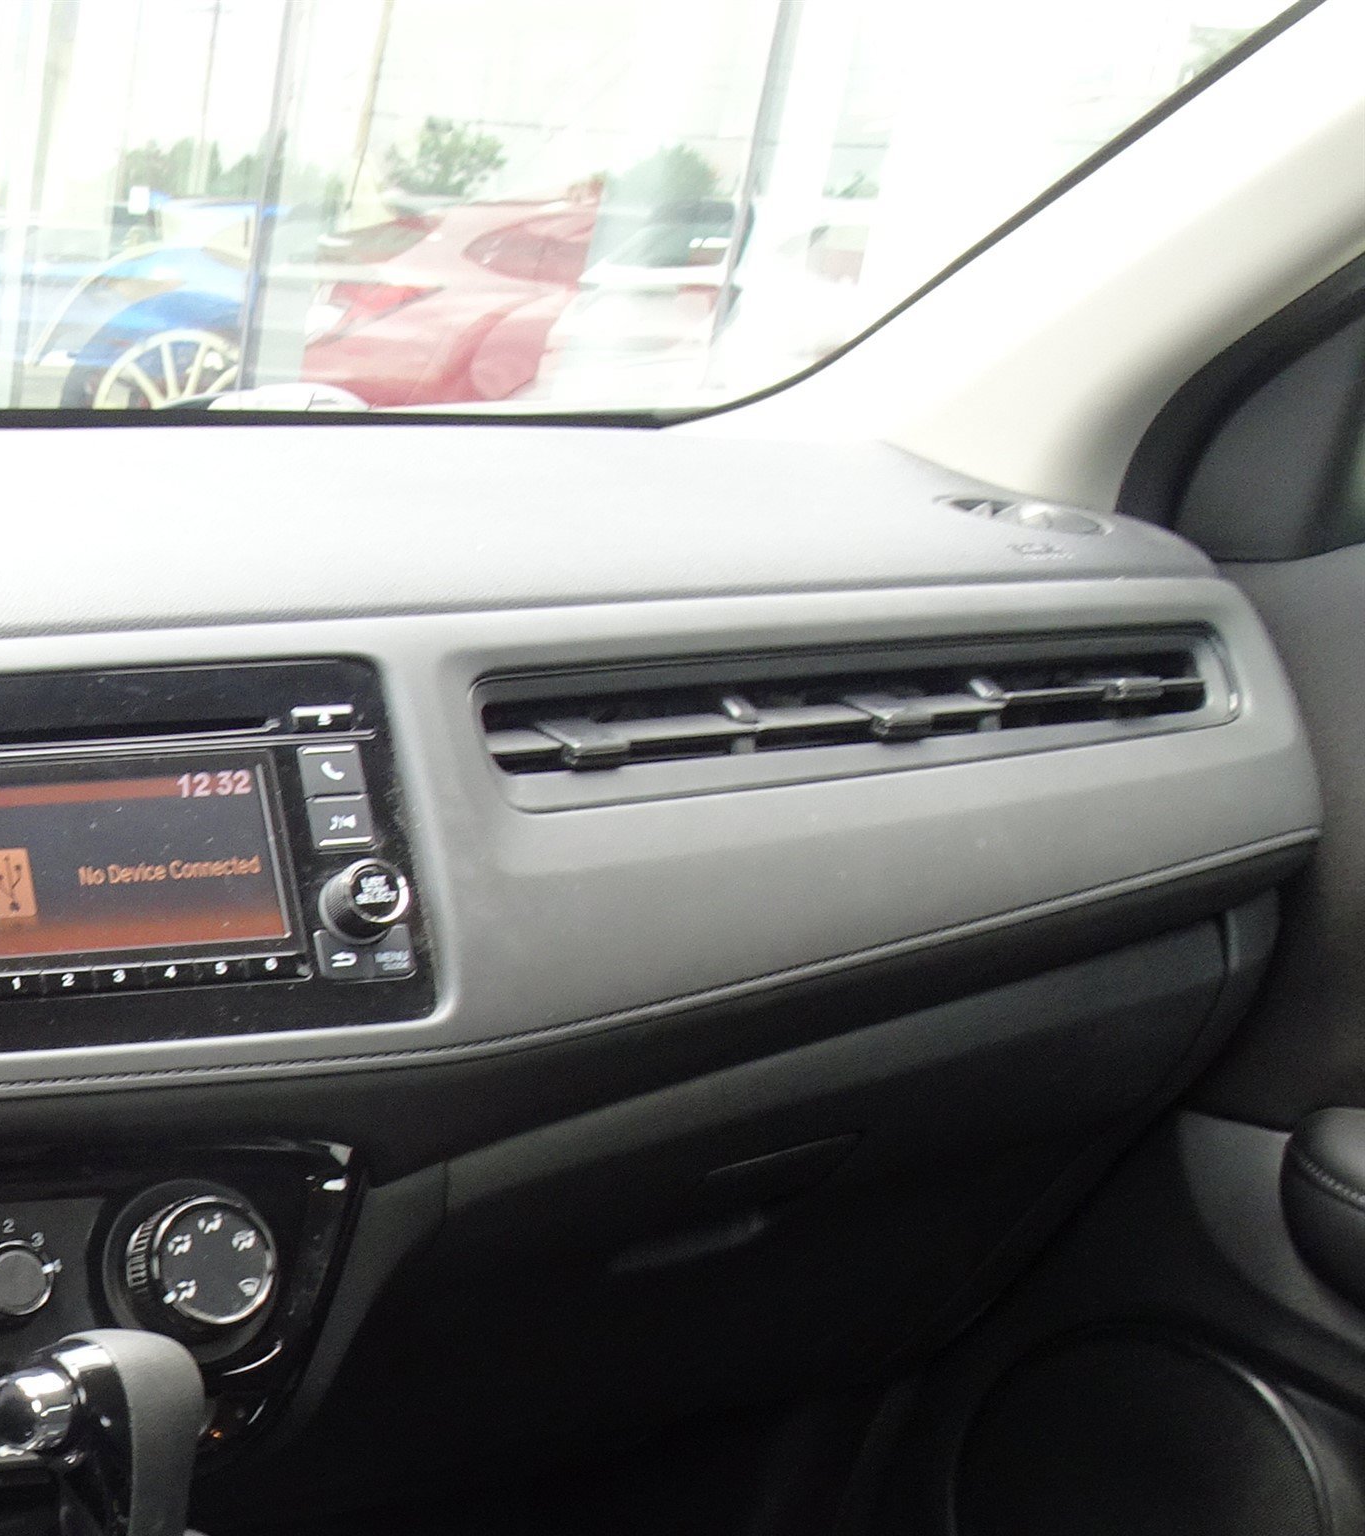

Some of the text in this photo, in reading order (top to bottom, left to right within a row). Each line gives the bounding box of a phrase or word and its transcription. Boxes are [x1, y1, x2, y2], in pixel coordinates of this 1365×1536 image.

[78, 855, 262, 886] No Device Connected
[11, 957, 278, 990] 1 2 3 4 5 6
[2, 1218, 16, 1234] 2
[31, 1231, 45, 1247] 3
